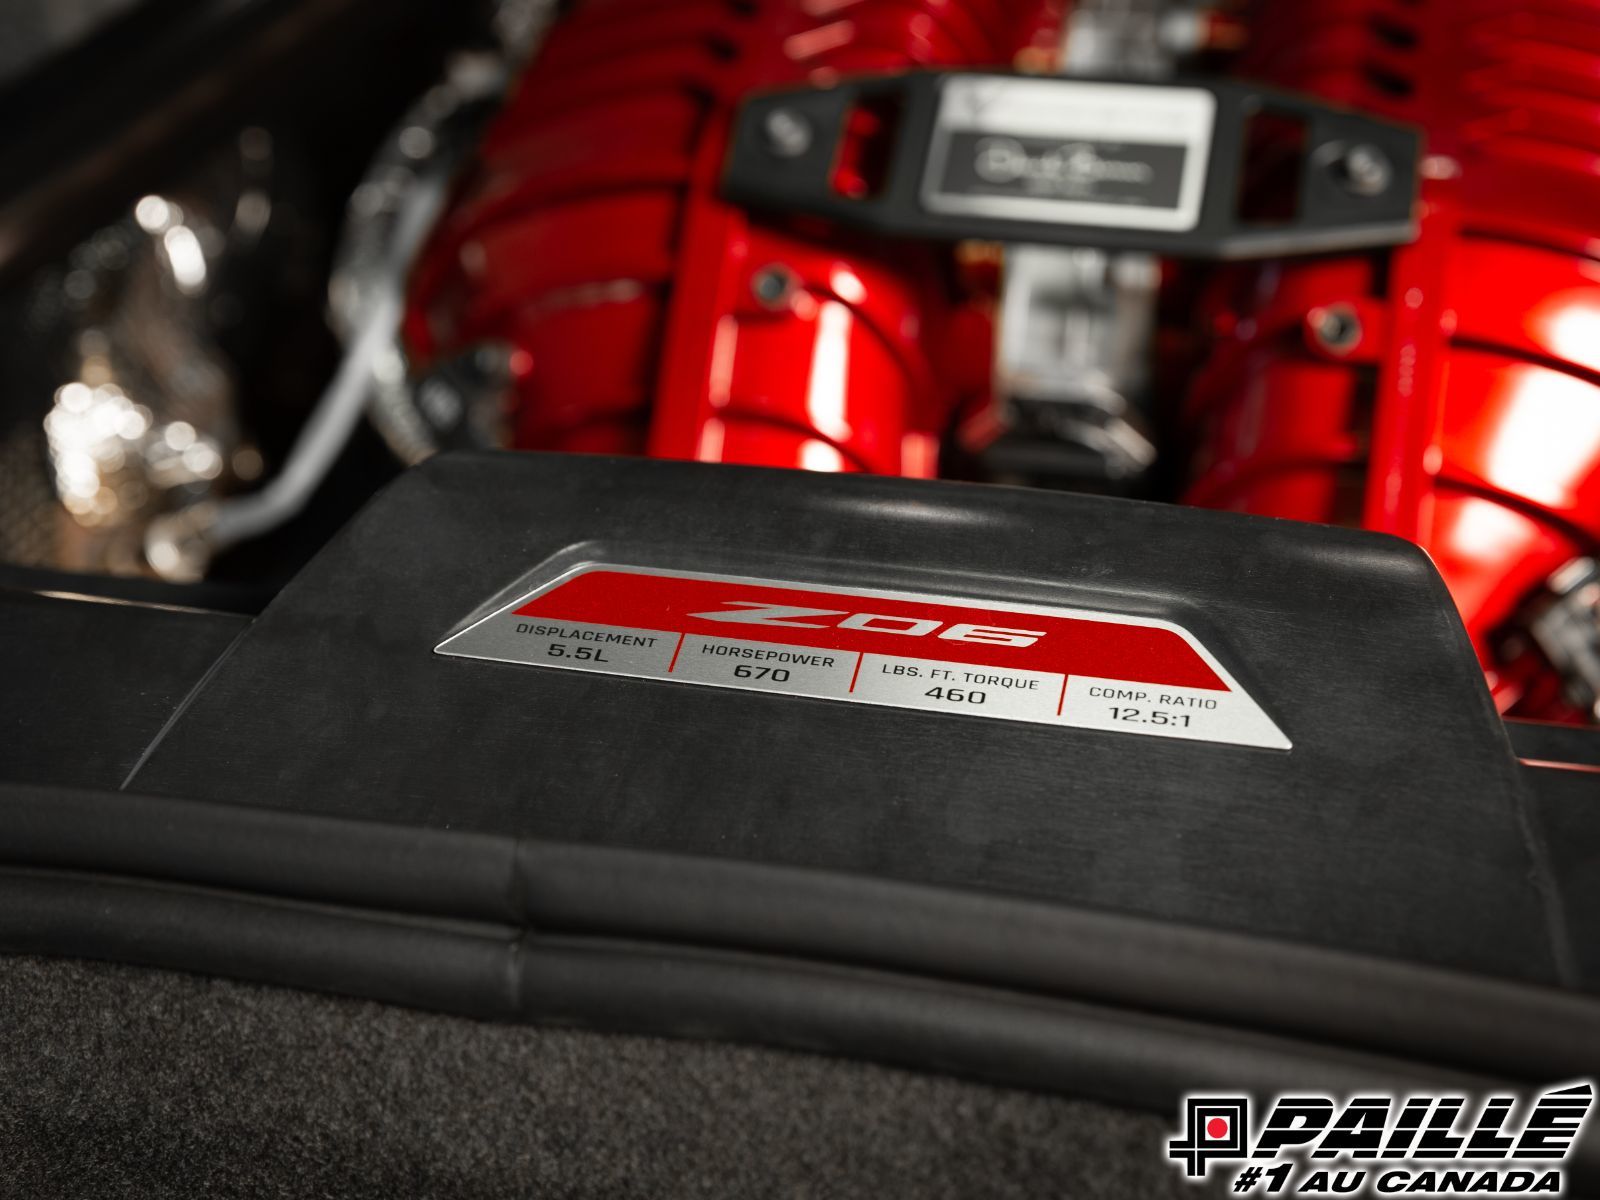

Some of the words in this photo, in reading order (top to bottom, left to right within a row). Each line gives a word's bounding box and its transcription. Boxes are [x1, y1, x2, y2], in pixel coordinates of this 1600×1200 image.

[516, 622, 658, 649] DISPLACEMENT
[686, 601, 1047, 648] Z06
[547, 643, 609, 663] 5.5L
[702, 643, 835, 668] HORSEPOWER
[733, 664, 790, 683] 670
[882, 663, 923, 678] LBS.
[930, 669, 956, 682] FT.
[963, 672, 1040, 691] TORQUE
[924, 686, 987, 706] 460
[1089, 686, 1152, 704] COMP.
[1159, 694, 1217, 711] RATIO
[1108, 706, 1191, 728] 12.5:1
